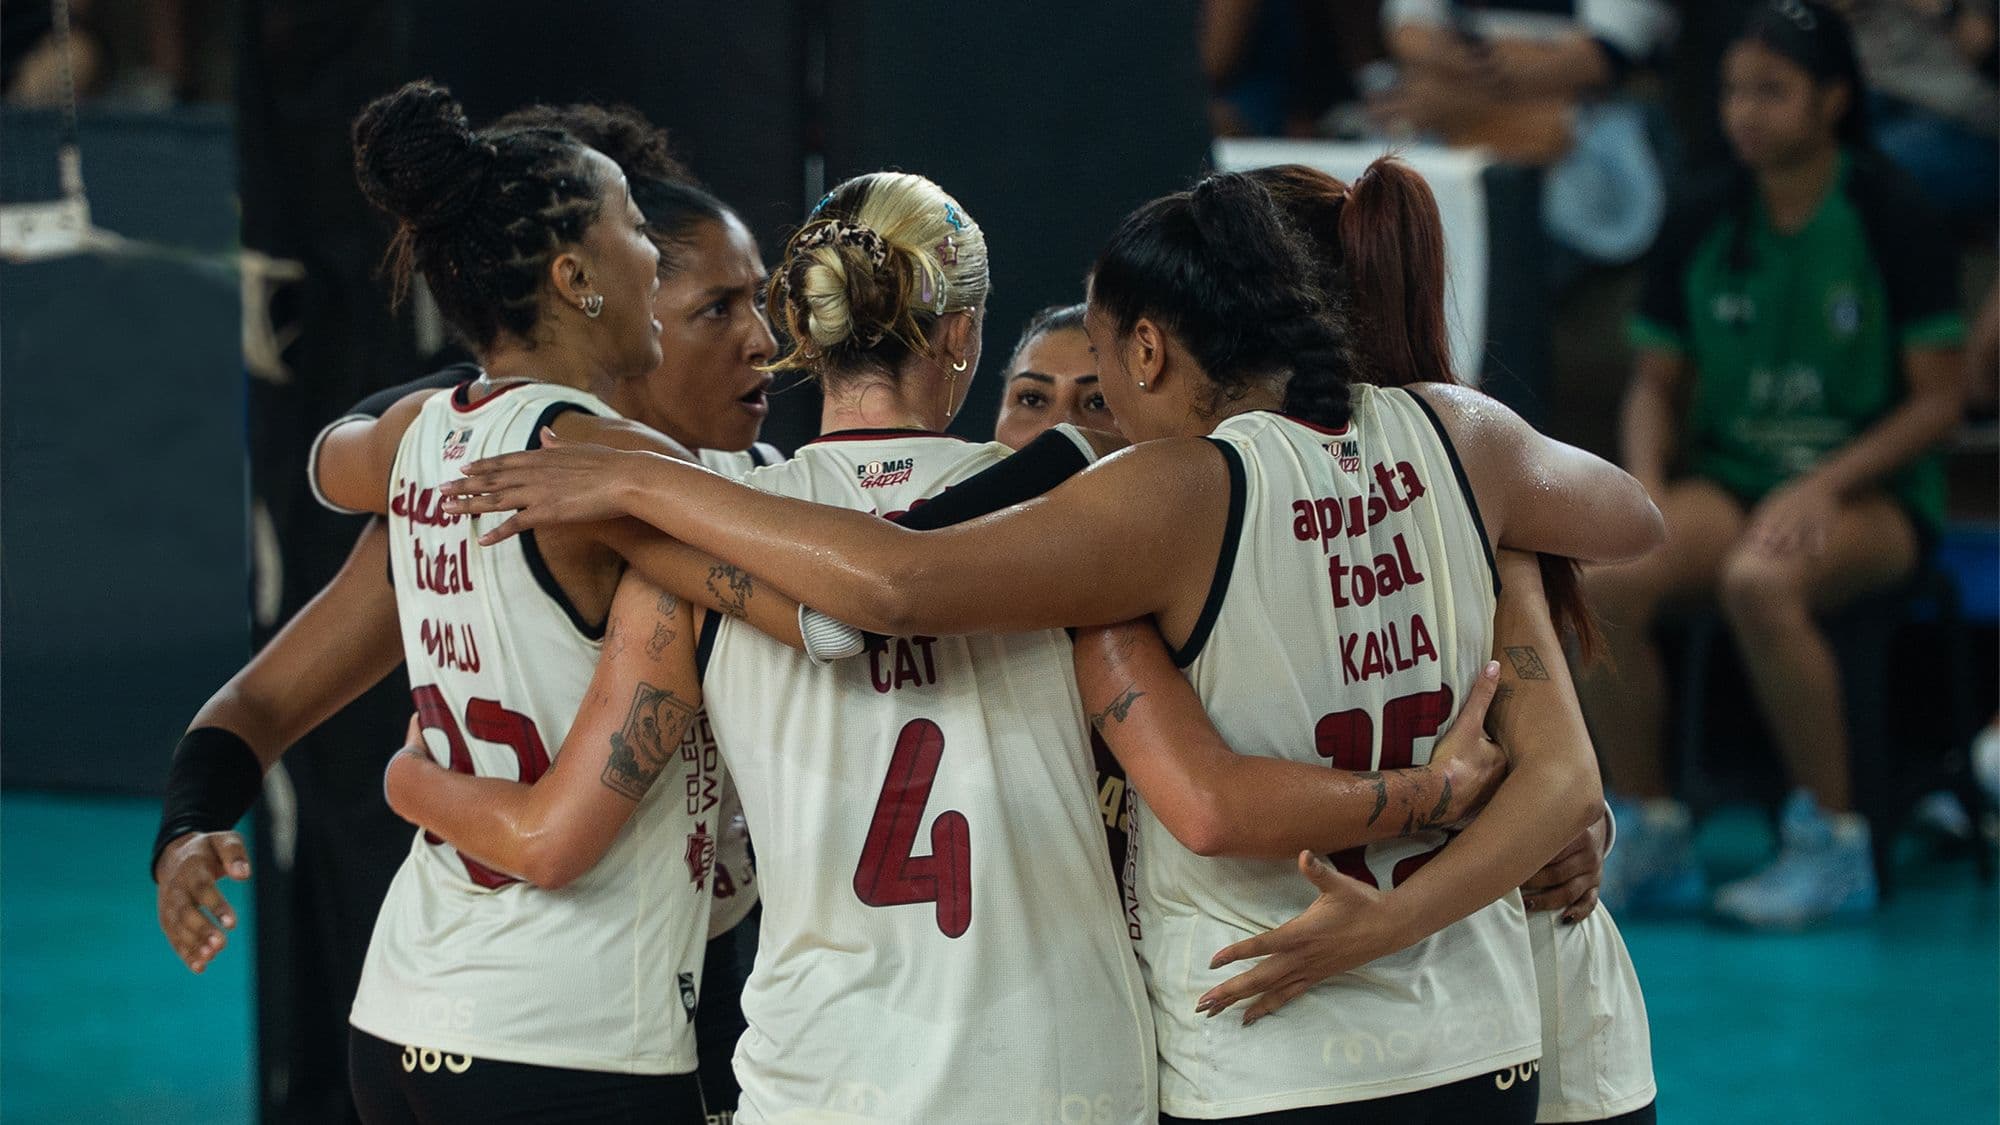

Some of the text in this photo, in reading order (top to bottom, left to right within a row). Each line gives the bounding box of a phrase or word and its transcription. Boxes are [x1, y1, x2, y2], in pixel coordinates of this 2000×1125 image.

[857, 457, 913, 479] PUMAS
[869, 635, 938, 694] CAT
[853, 717, 972, 938] 4
